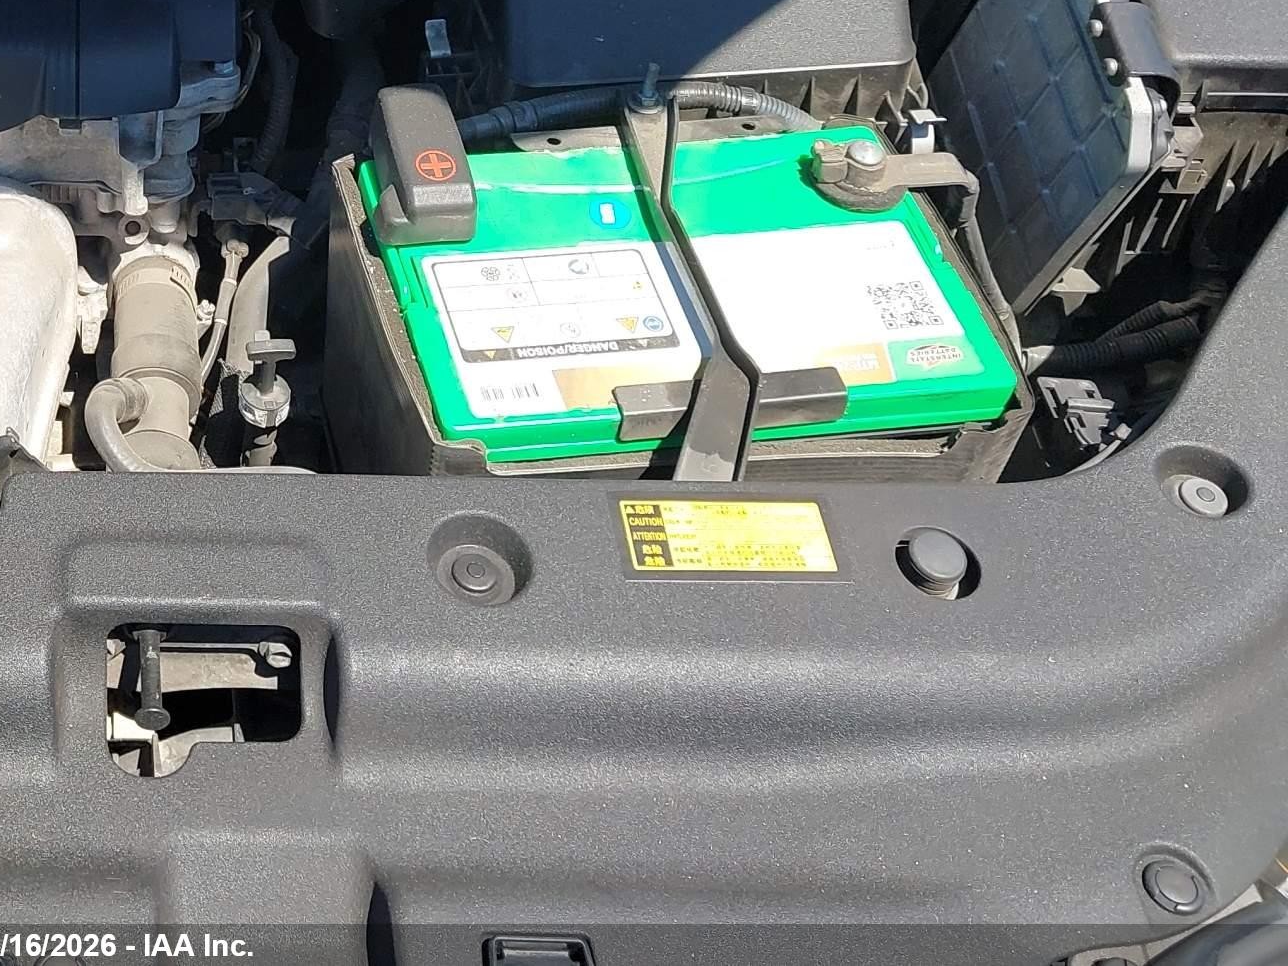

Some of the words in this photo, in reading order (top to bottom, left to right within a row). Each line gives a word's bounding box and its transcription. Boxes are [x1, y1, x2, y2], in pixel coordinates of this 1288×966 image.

[517, 341, 620, 358] DANGER/POISON
[629, 516, 664, 526] CAUTION
[632, 531, 667, 541] ATTENTION
